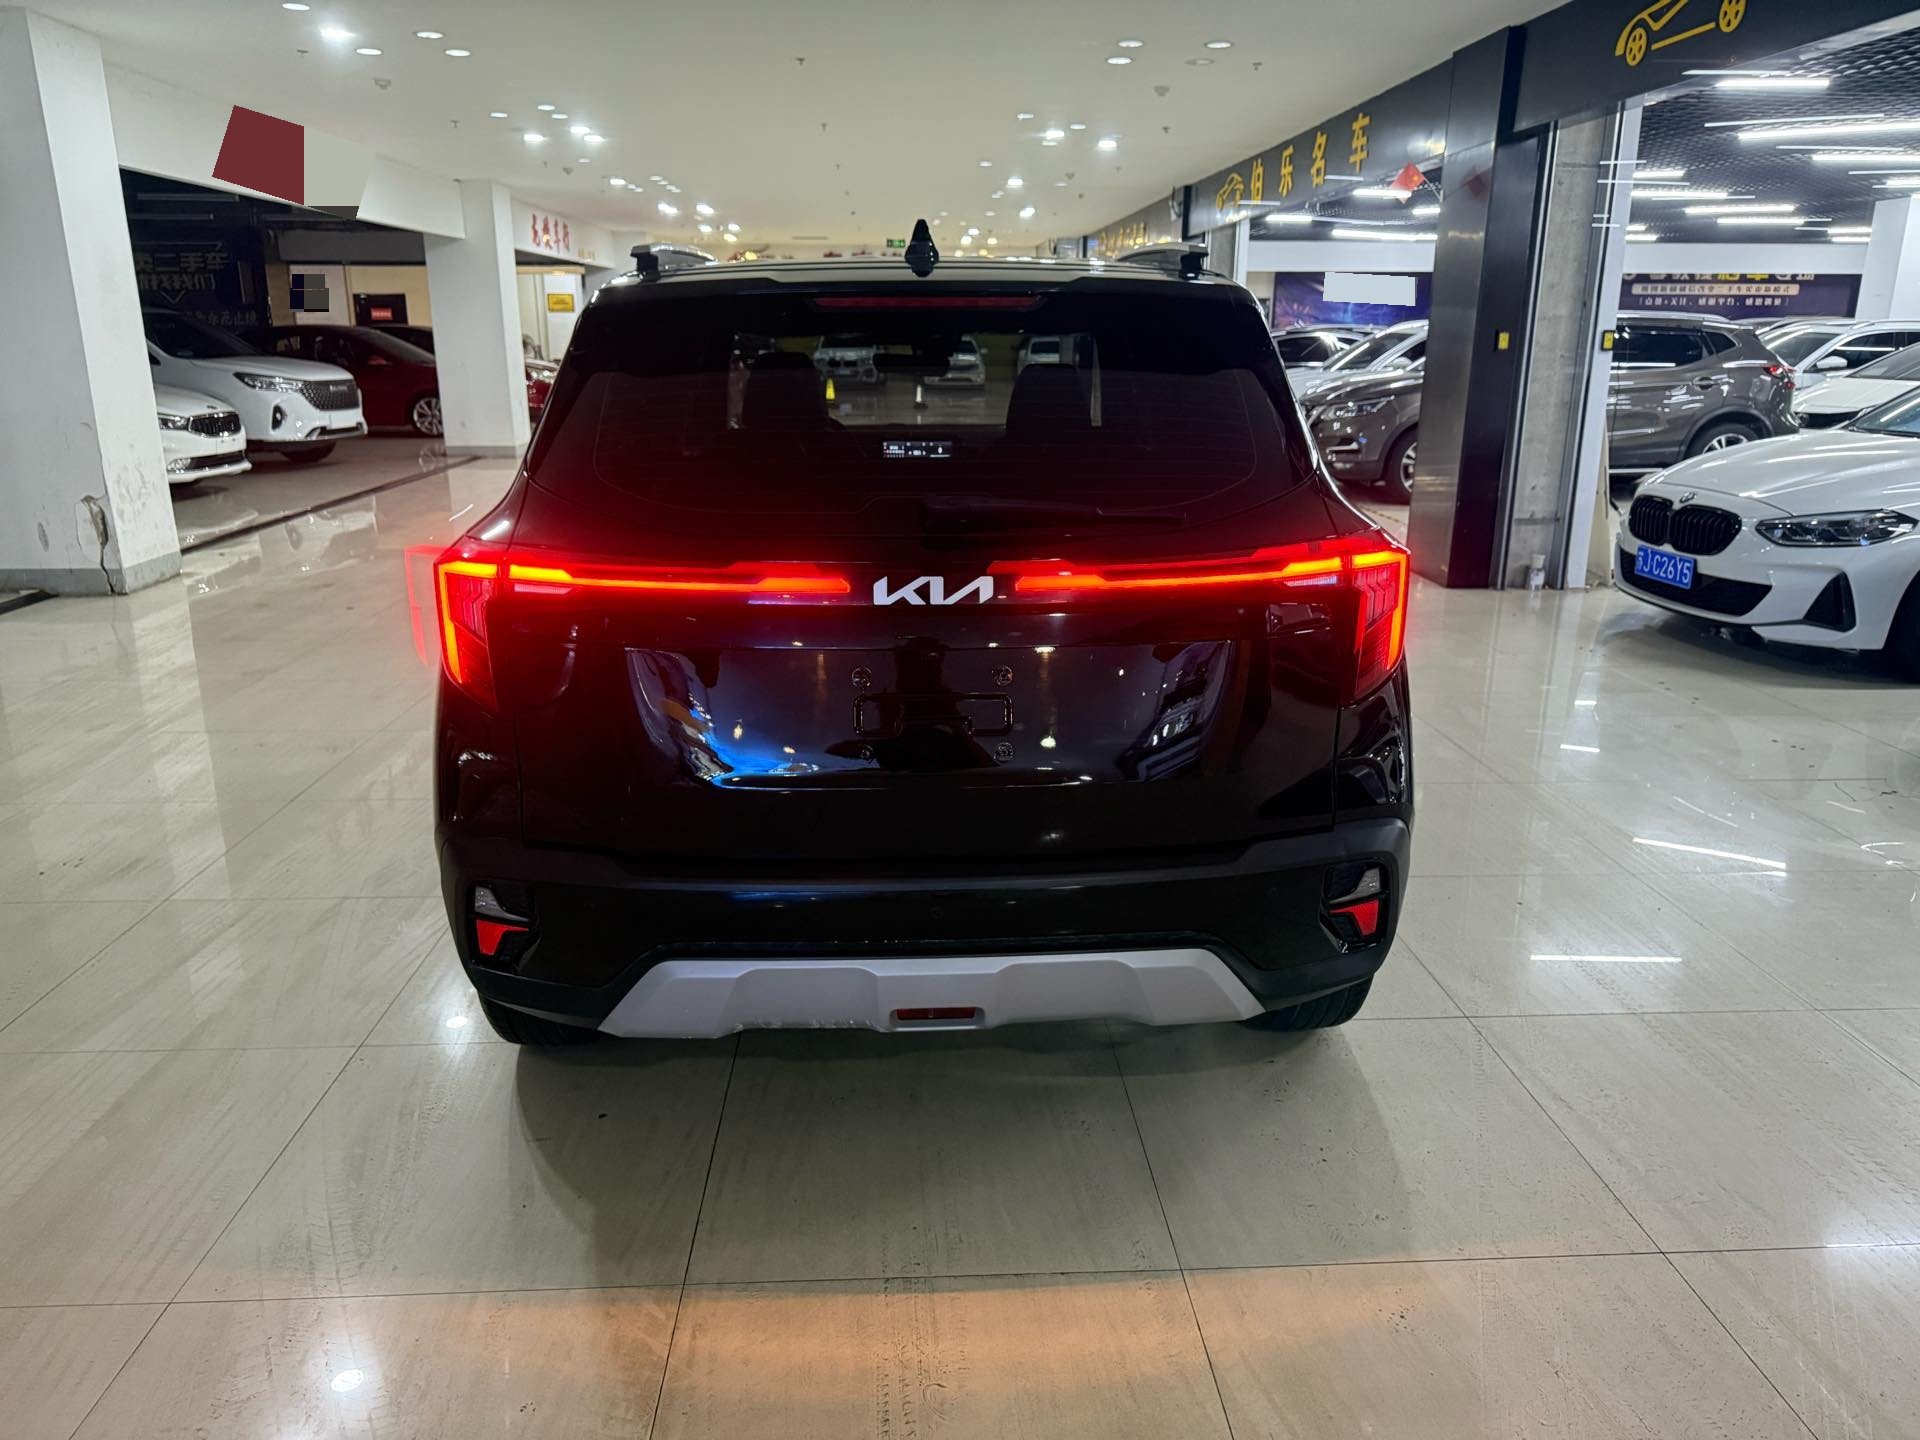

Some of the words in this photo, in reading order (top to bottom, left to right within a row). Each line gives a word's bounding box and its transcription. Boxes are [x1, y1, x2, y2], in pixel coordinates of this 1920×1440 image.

[1250, 112, 1371, 204] 伯乐名车
[873, 576, 994, 605] KIA
